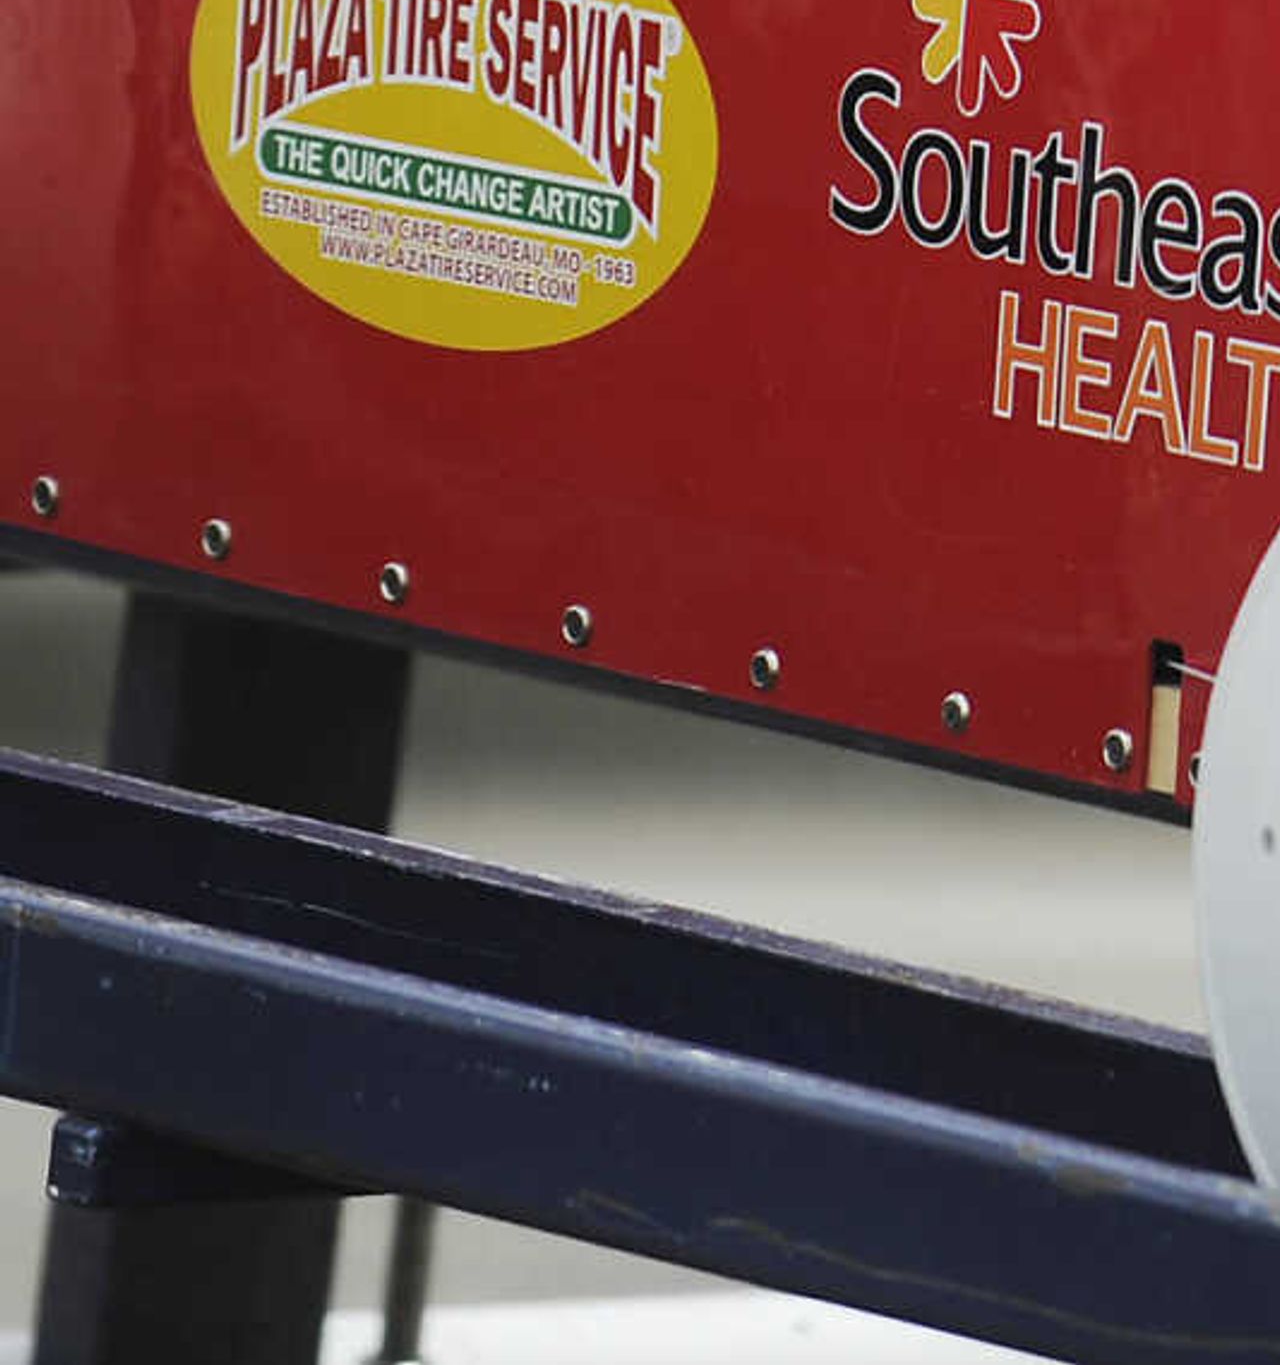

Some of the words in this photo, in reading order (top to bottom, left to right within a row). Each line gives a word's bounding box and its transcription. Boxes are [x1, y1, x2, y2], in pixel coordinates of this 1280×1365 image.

[273, 135, 324, 176] THE
[330, 144, 413, 193] QUICK
[417, 162, 525, 216] CHANGE
[527, 184, 620, 234] ARTIST
[262, 190, 372, 233] ESTABLISHED
[377, 213, 395, 237] IN
[400, 218, 443, 248] CAPE
[594, 254, 636, 287] 1963
[322, 234, 577, 304] WWW.PLAZATIRESERVICE.COM
